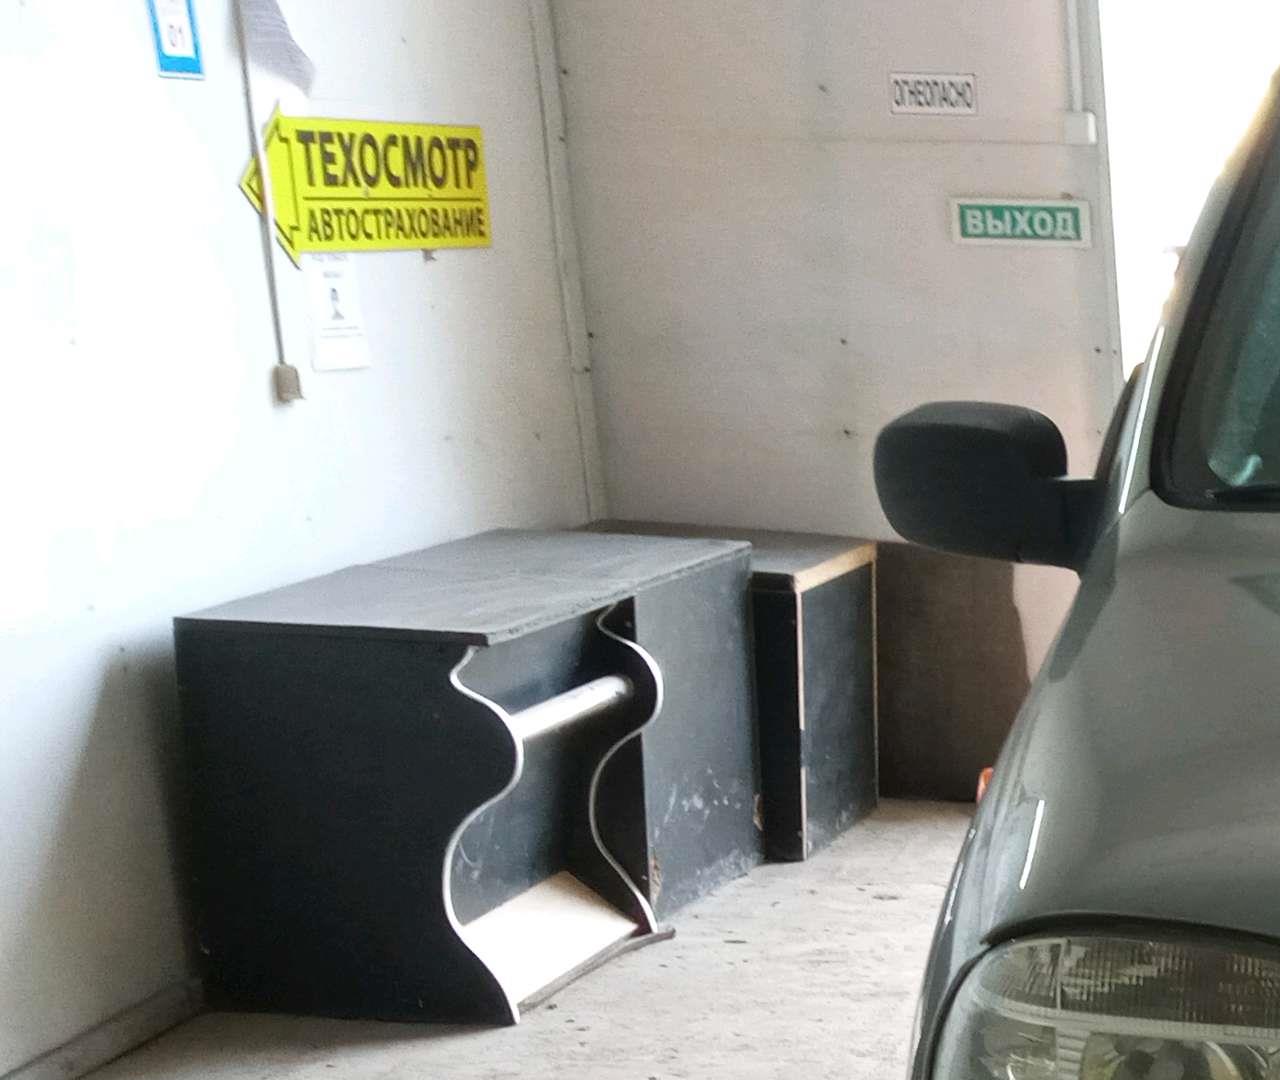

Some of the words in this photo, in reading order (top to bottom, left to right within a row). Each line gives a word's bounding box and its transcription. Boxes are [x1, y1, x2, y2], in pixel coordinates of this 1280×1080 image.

[296, 129, 479, 190] ТЕХОСМОТР
[307, 206, 486, 242] АВТОСТРАХОВАНИЕ
[964, 208, 1077, 239] ВЫХОД
